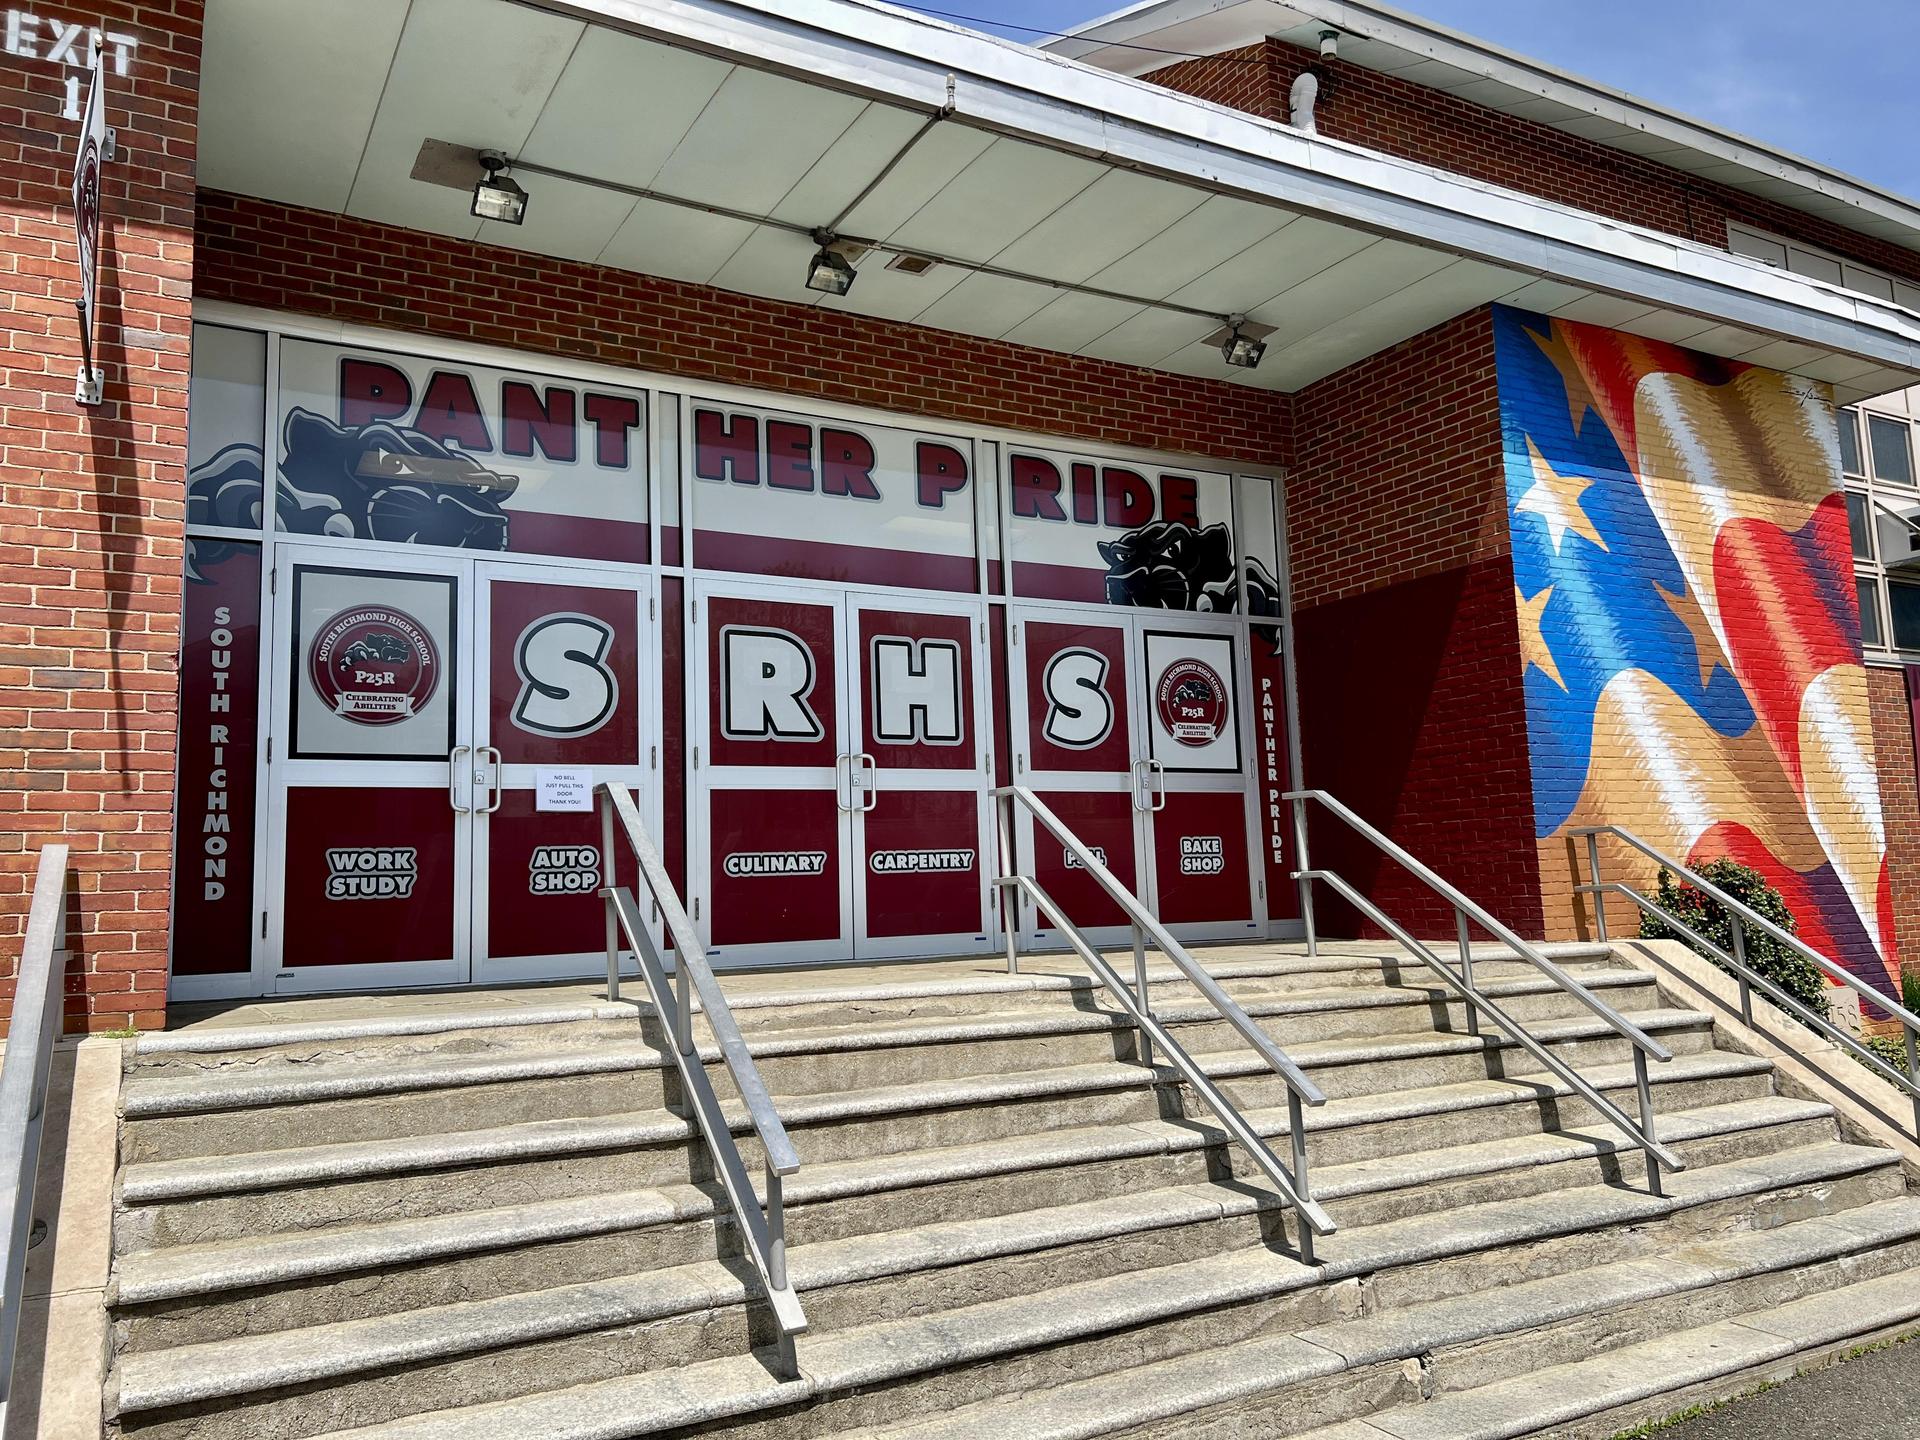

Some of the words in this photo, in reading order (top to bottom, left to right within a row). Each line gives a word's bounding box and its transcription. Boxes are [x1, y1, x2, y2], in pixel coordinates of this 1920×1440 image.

[6, 9, 138, 77] EXIT
[62, 76, 80, 120] 1
[338, 355, 880, 500] PANTHER
[914, 440, 1200, 530] PRIDE
[318, 632, 337, 662] SOUTH
[335, 612, 387, 634] RICHMOND
[388, 615, 412, 634] HIGH
[410, 630, 431, 666] SCHOOL
[209, 606, 234, 713] SOUTH
[355, 670, 396, 686] P25R
[1160, 678, 1171, 701] SOUTH
[1168, 664, 1197, 681] RICHMOND
[1196, 665, 1212, 680] HIGH
[1210, 677, 1224, 703] SCHOOL
[1181, 706, 1205, 718] P25R
[1261, 678, 1278, 781] PANTHER
[203, 724, 232, 901] RICHMOND
[1269, 789, 1283, 864] PRIDE
[1182, 840, 1221, 854] BAKE
[331, 851, 413, 871] WORK
[533, 850, 597, 868] AUTO
[726, 853, 824, 873] CULINARY
[872, 851, 973, 871] CARPENTRY
[1182, 857, 1222, 872] SHOP
[330, 875, 414, 896] STUDY
[533, 872, 597, 891] SHOP
